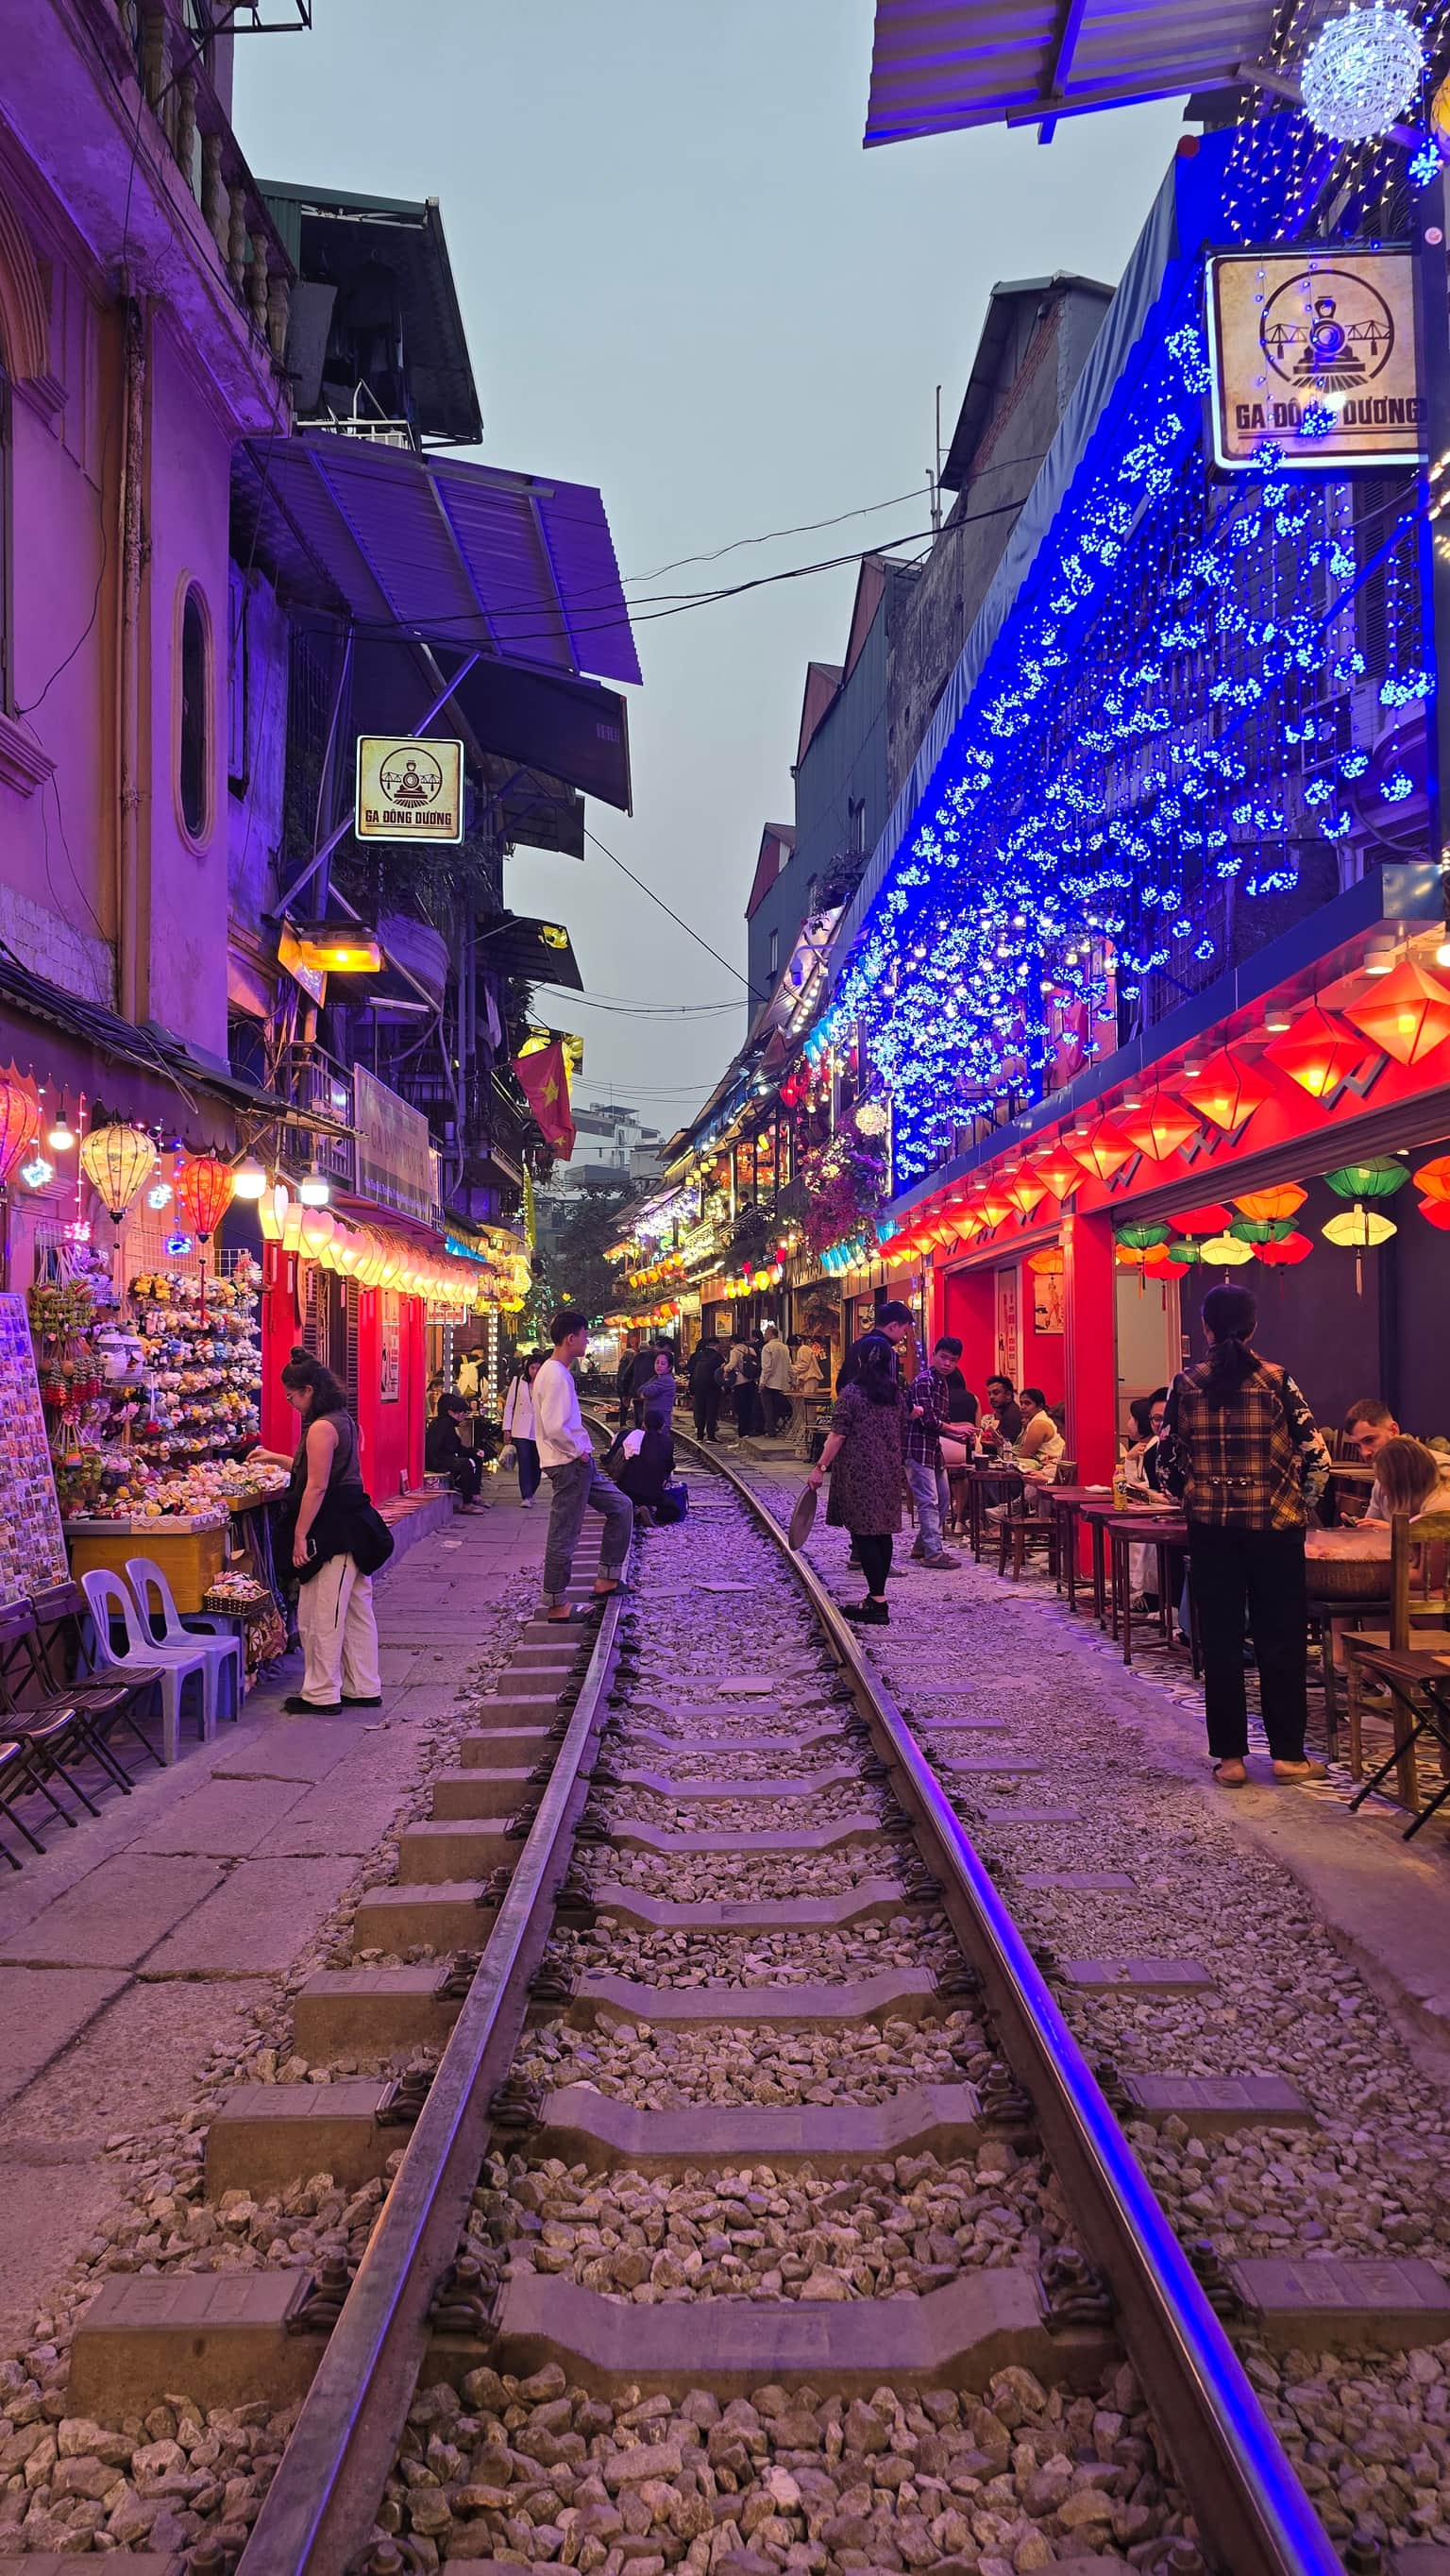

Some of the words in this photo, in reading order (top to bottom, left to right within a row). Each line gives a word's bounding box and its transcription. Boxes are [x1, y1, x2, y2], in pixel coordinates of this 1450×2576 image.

[1236, 403, 1266, 429] GA
[365, 809, 379, 822] GA
[382, 808, 413, 823] ĐÔNG
[415, 810, 452, 825] DƯƠNG
